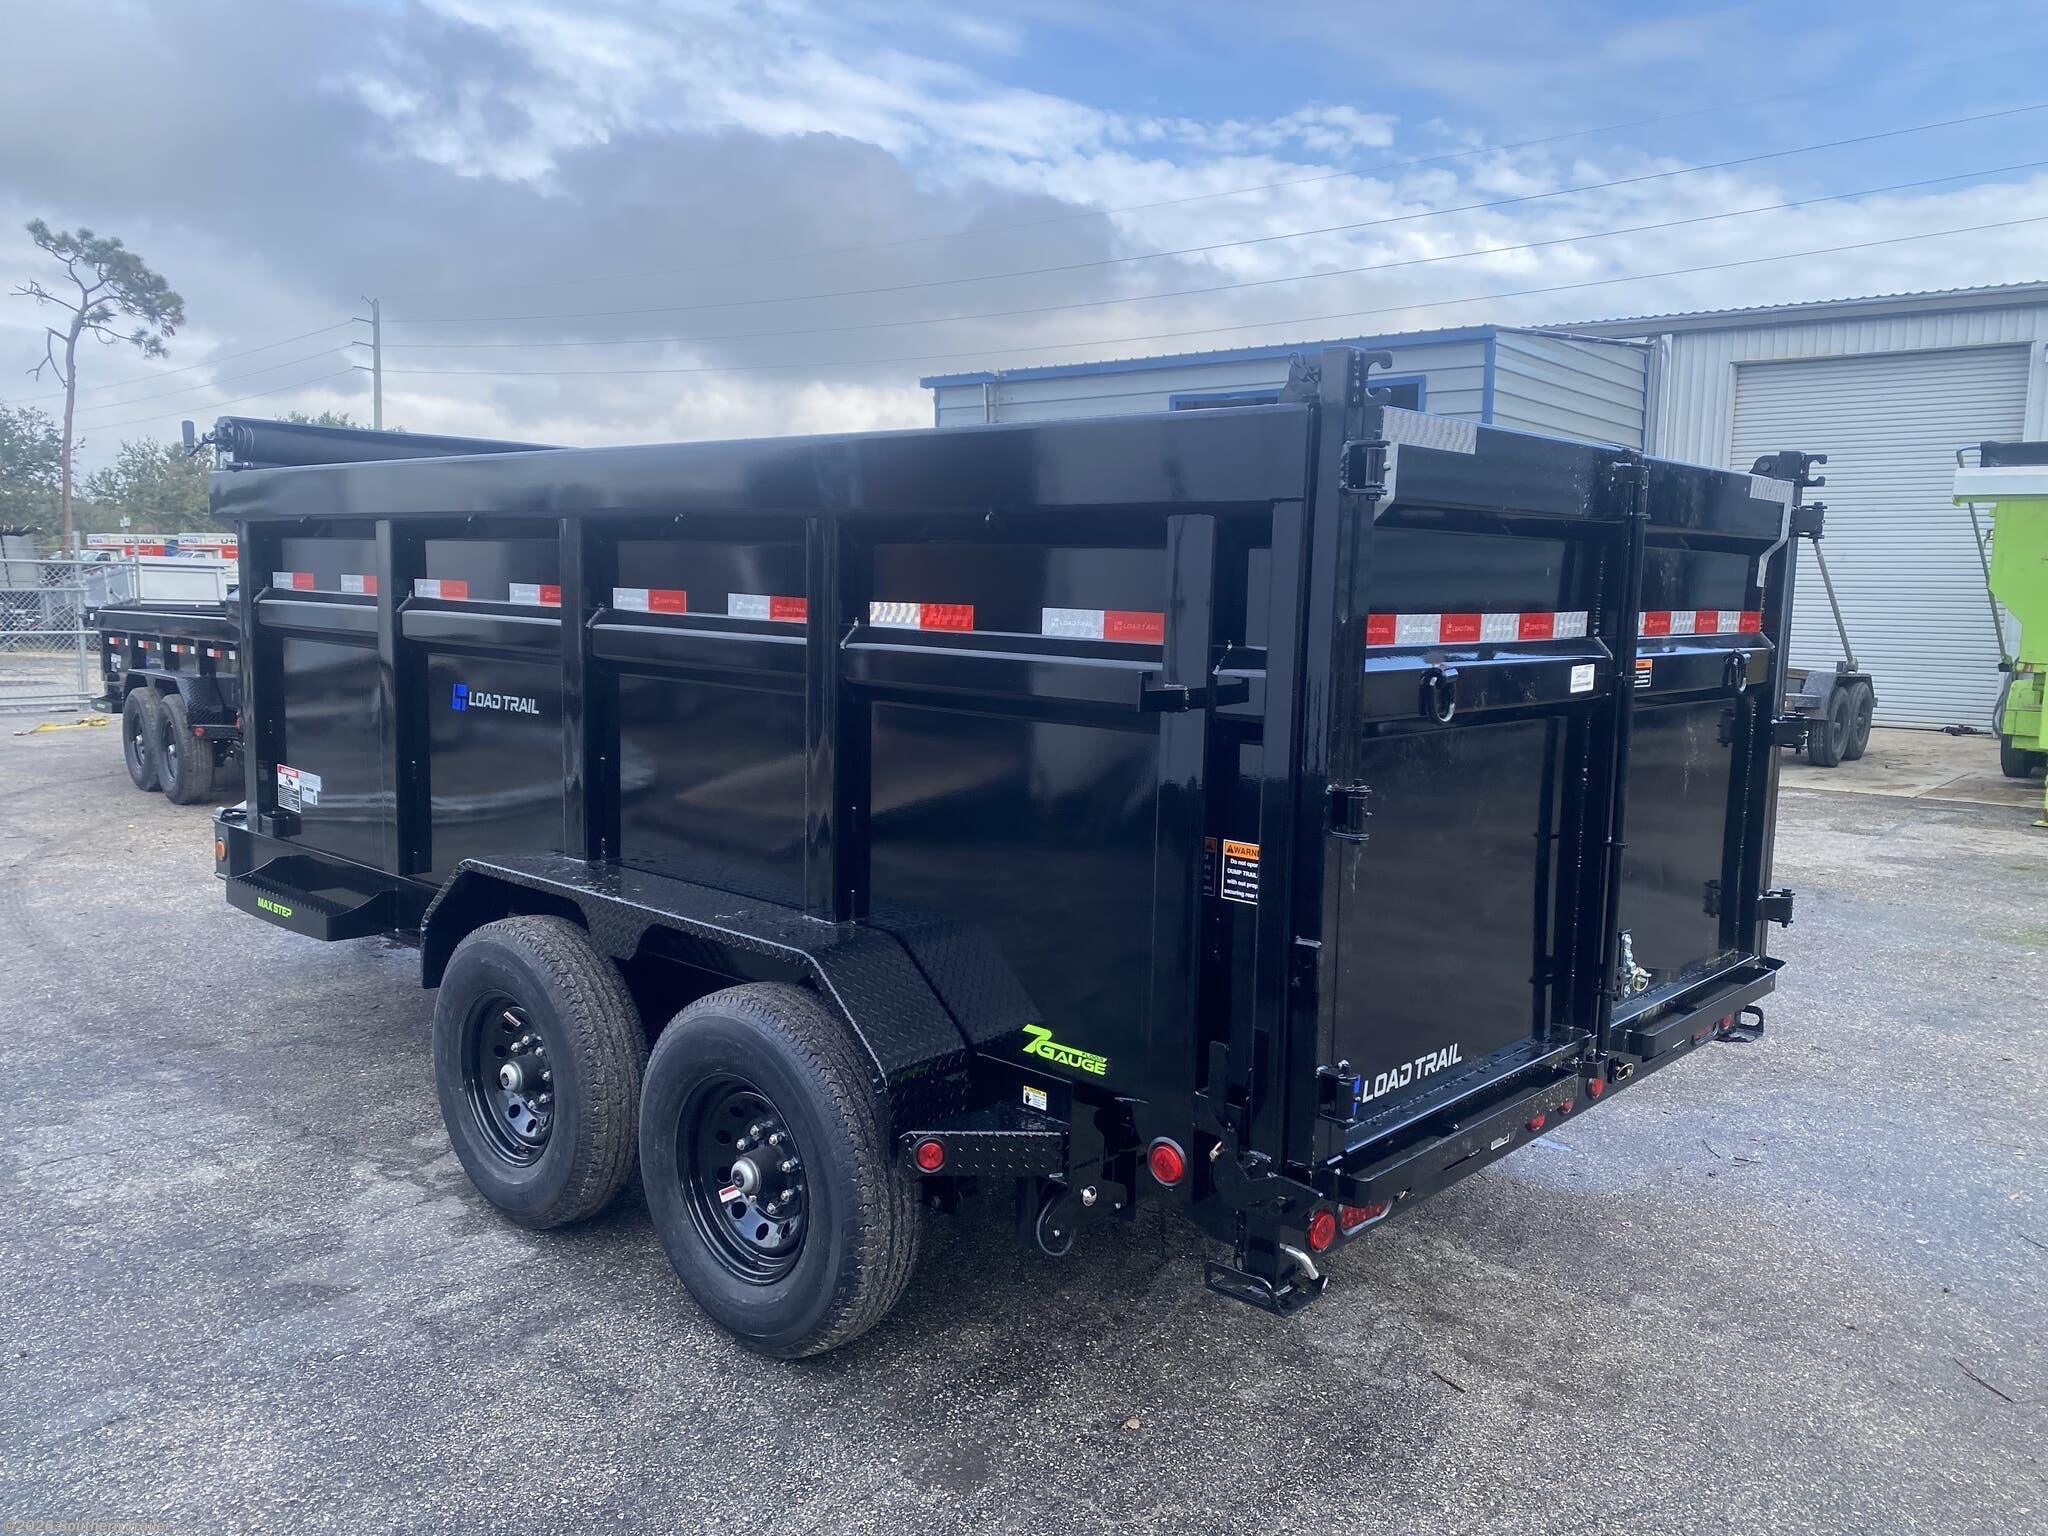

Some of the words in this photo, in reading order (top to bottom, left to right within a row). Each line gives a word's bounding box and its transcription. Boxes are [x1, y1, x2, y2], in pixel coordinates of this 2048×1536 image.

[468, 691, 501, 709] LOAD
[502, 695, 540, 714] TRAIL
[1224, 889, 1244, 898] securing
[257, 896, 273, 911] MAX
[273, 903, 292, 918] STEP
[1362, 1062, 1413, 1104] LOAD
[1415, 1043, 1462, 1080] TRAIL
